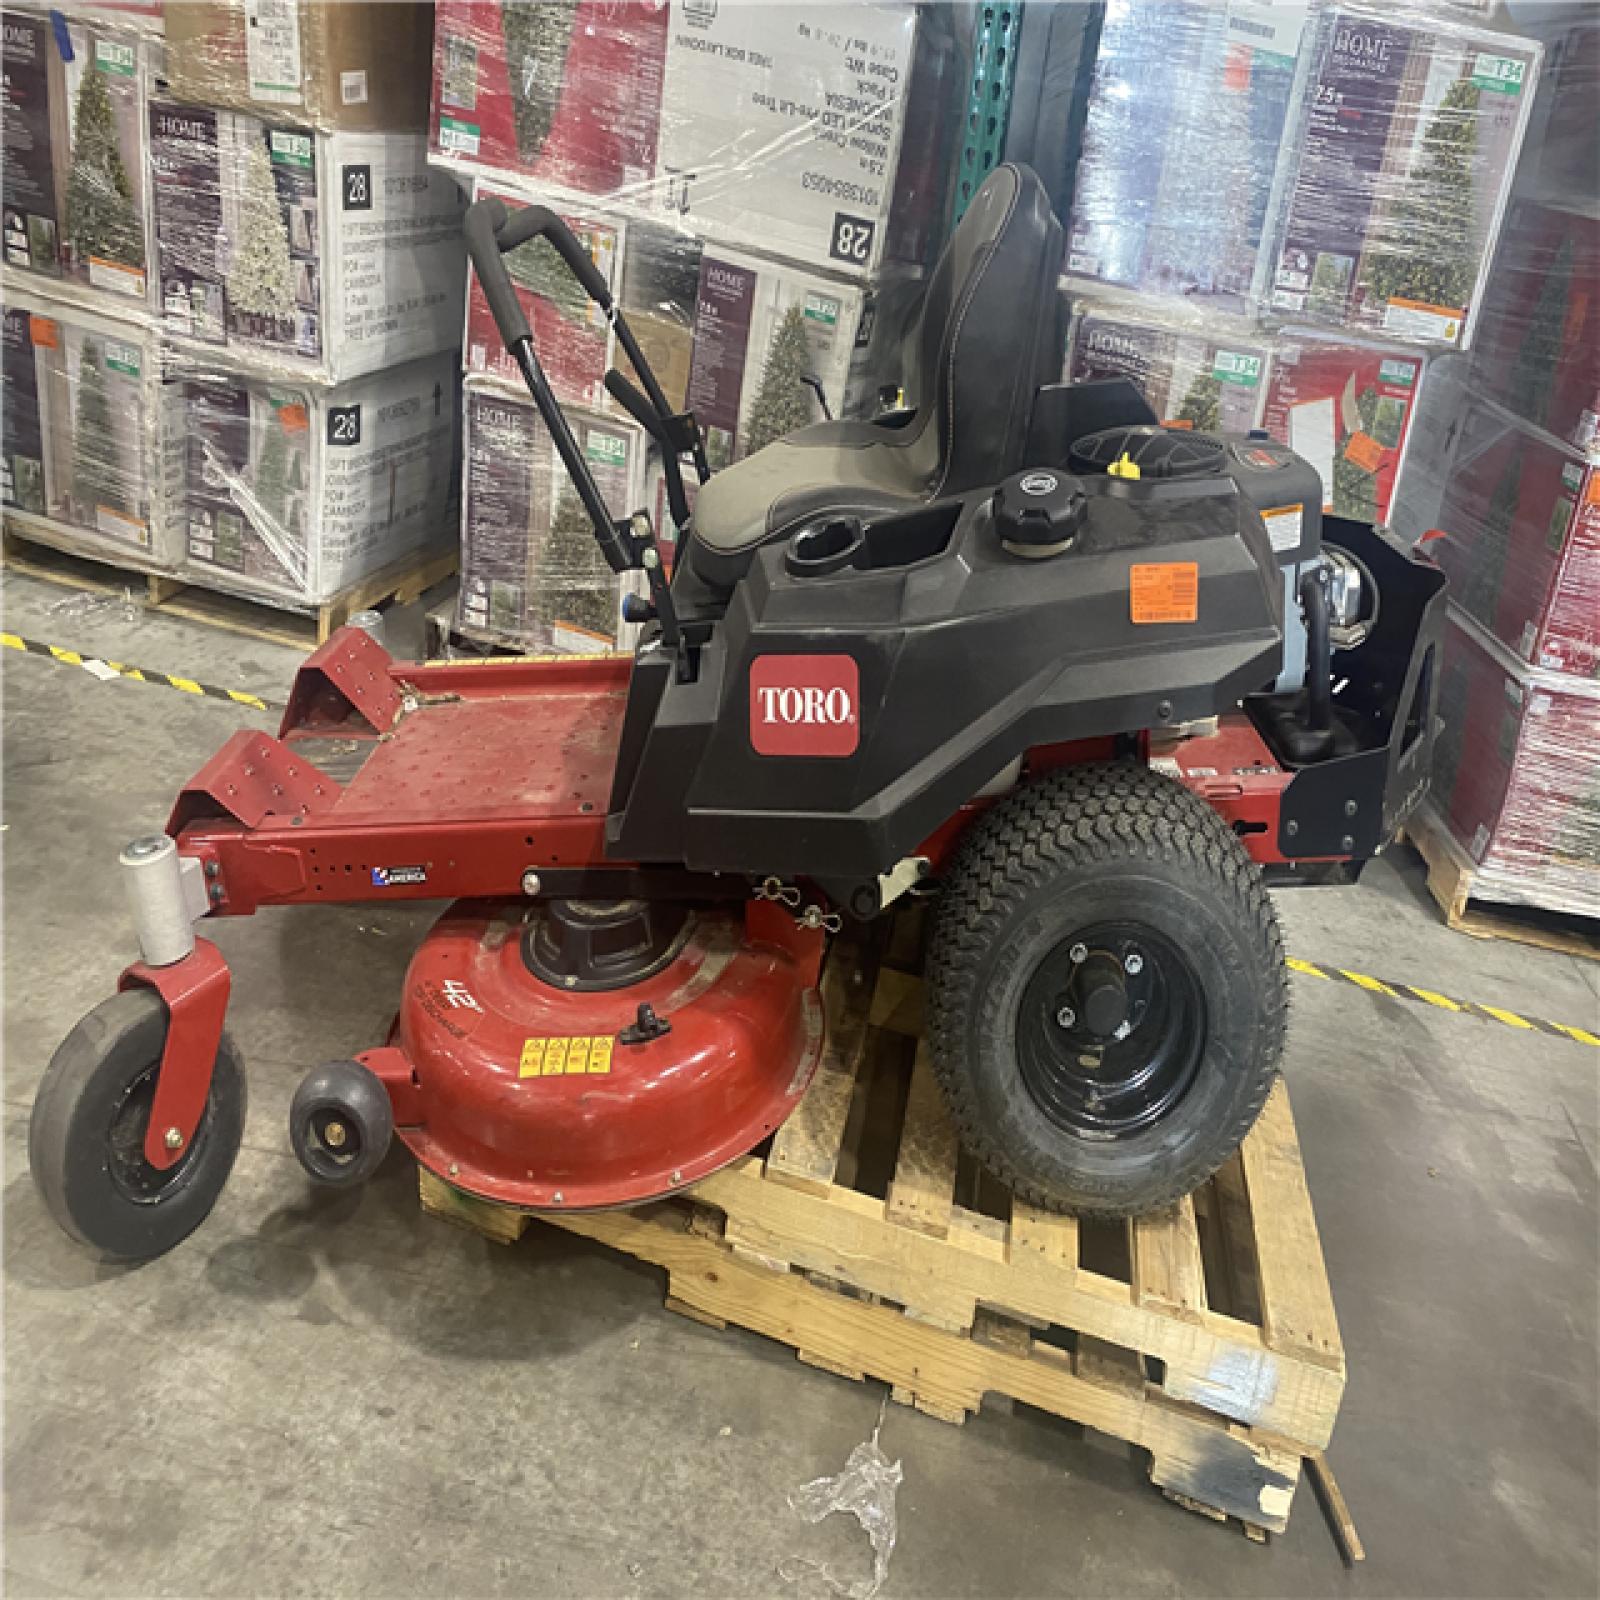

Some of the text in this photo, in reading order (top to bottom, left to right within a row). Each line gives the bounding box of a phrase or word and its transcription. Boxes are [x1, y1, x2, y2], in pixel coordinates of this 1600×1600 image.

[2, 24, 35, 43] OME
[867, 62, 898, 83] Case
[822, 112, 847, 129] LED
[347, 171, 367, 203] 28
[838, 223, 871, 259] 28
[757, 687, 850, 723] TORO
